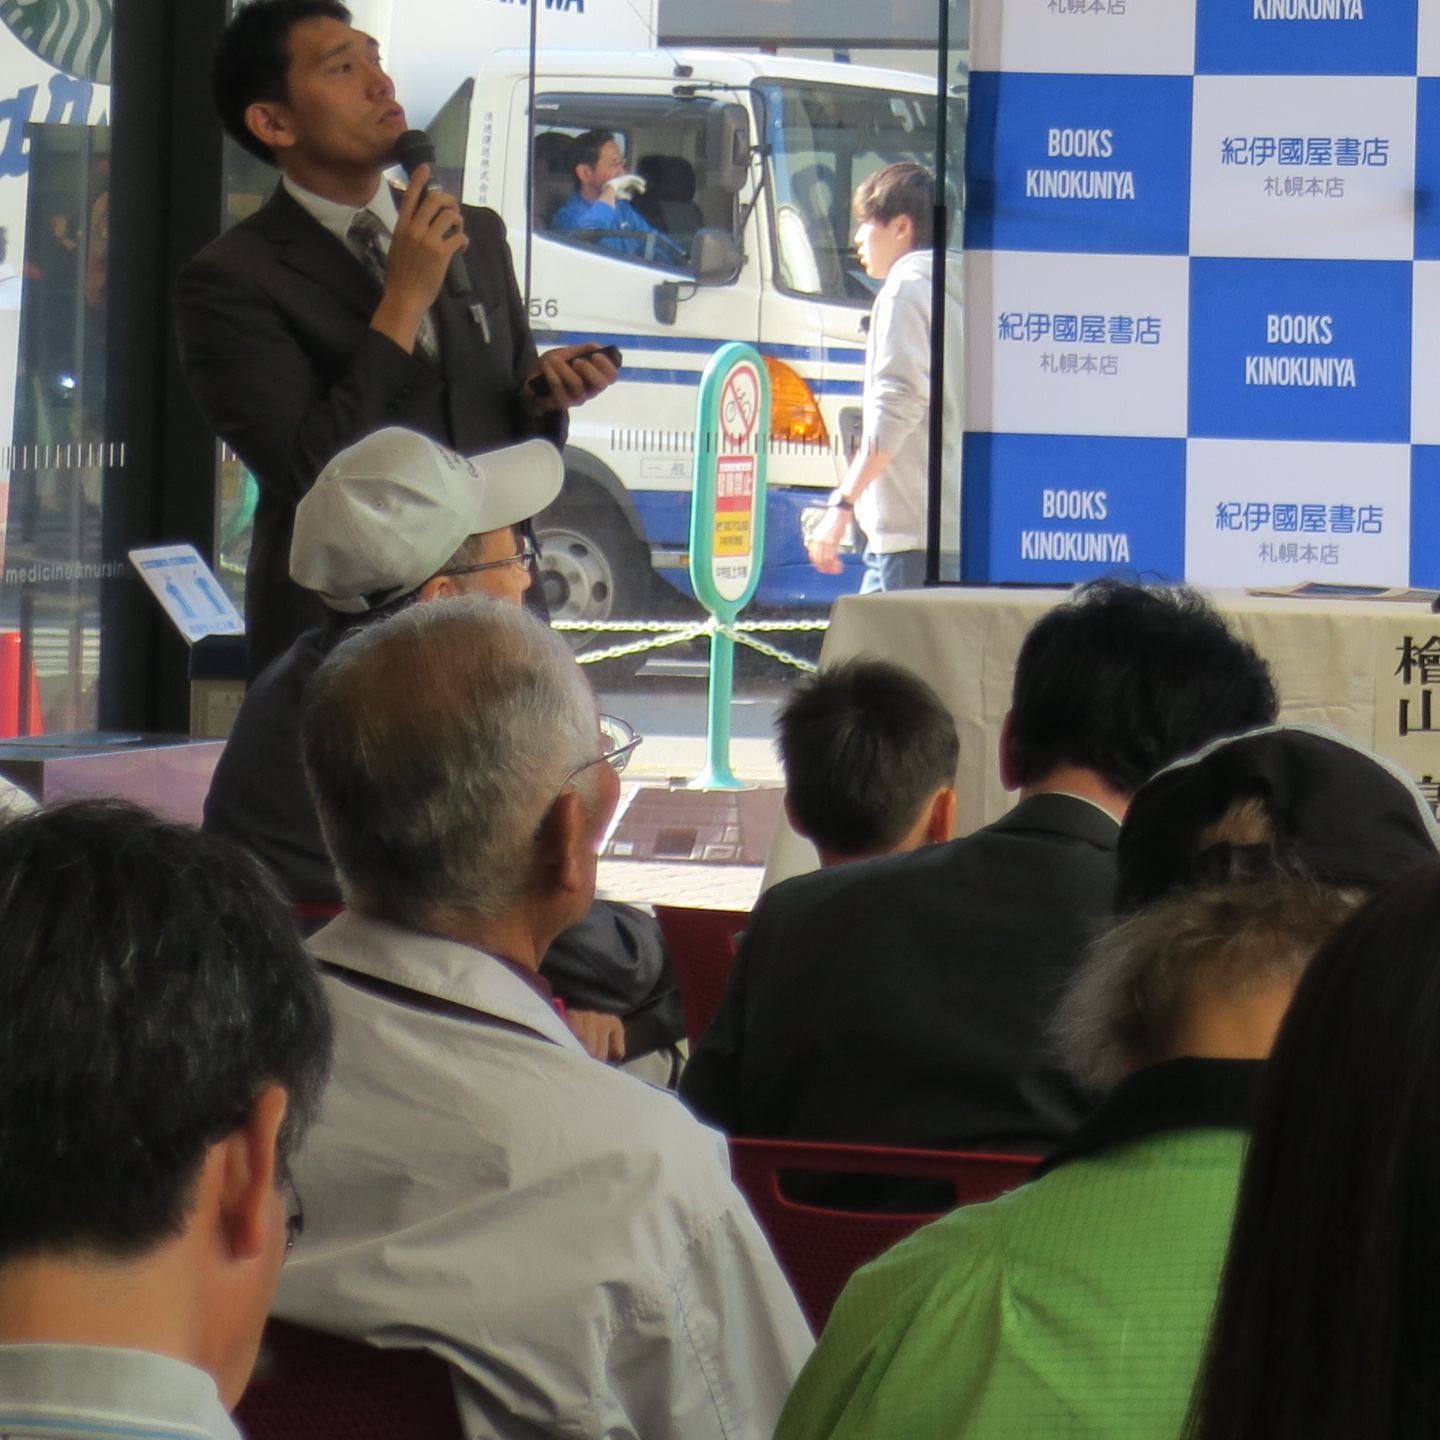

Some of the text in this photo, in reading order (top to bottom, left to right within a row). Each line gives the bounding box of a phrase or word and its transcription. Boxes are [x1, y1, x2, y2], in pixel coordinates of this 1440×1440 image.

[1049, 129, 1112, 157] BOOKS
[1222, 137, 1389, 166] 紀伊國屋書店
[1027, 170, 1134, 199] KINOKUNIYA
[1264, 176, 1344, 197] 札幌本店
[999, 313, 1161, 344] 紀伊國屋書店
[1268, 315, 1332, 344] BOOKS
[1040, 352, 1118, 375] 札幌本店
[1246, 357, 1355, 387] KINOKUNIYA
[1043, 490, 1106, 519] BOOKS
[1216, 502, 1383, 533] 紀伊國屋書店
[1022, 531, 1129, 562] KINOKUNIYA
[1259, 542, 1338, 564] 札幌本店
